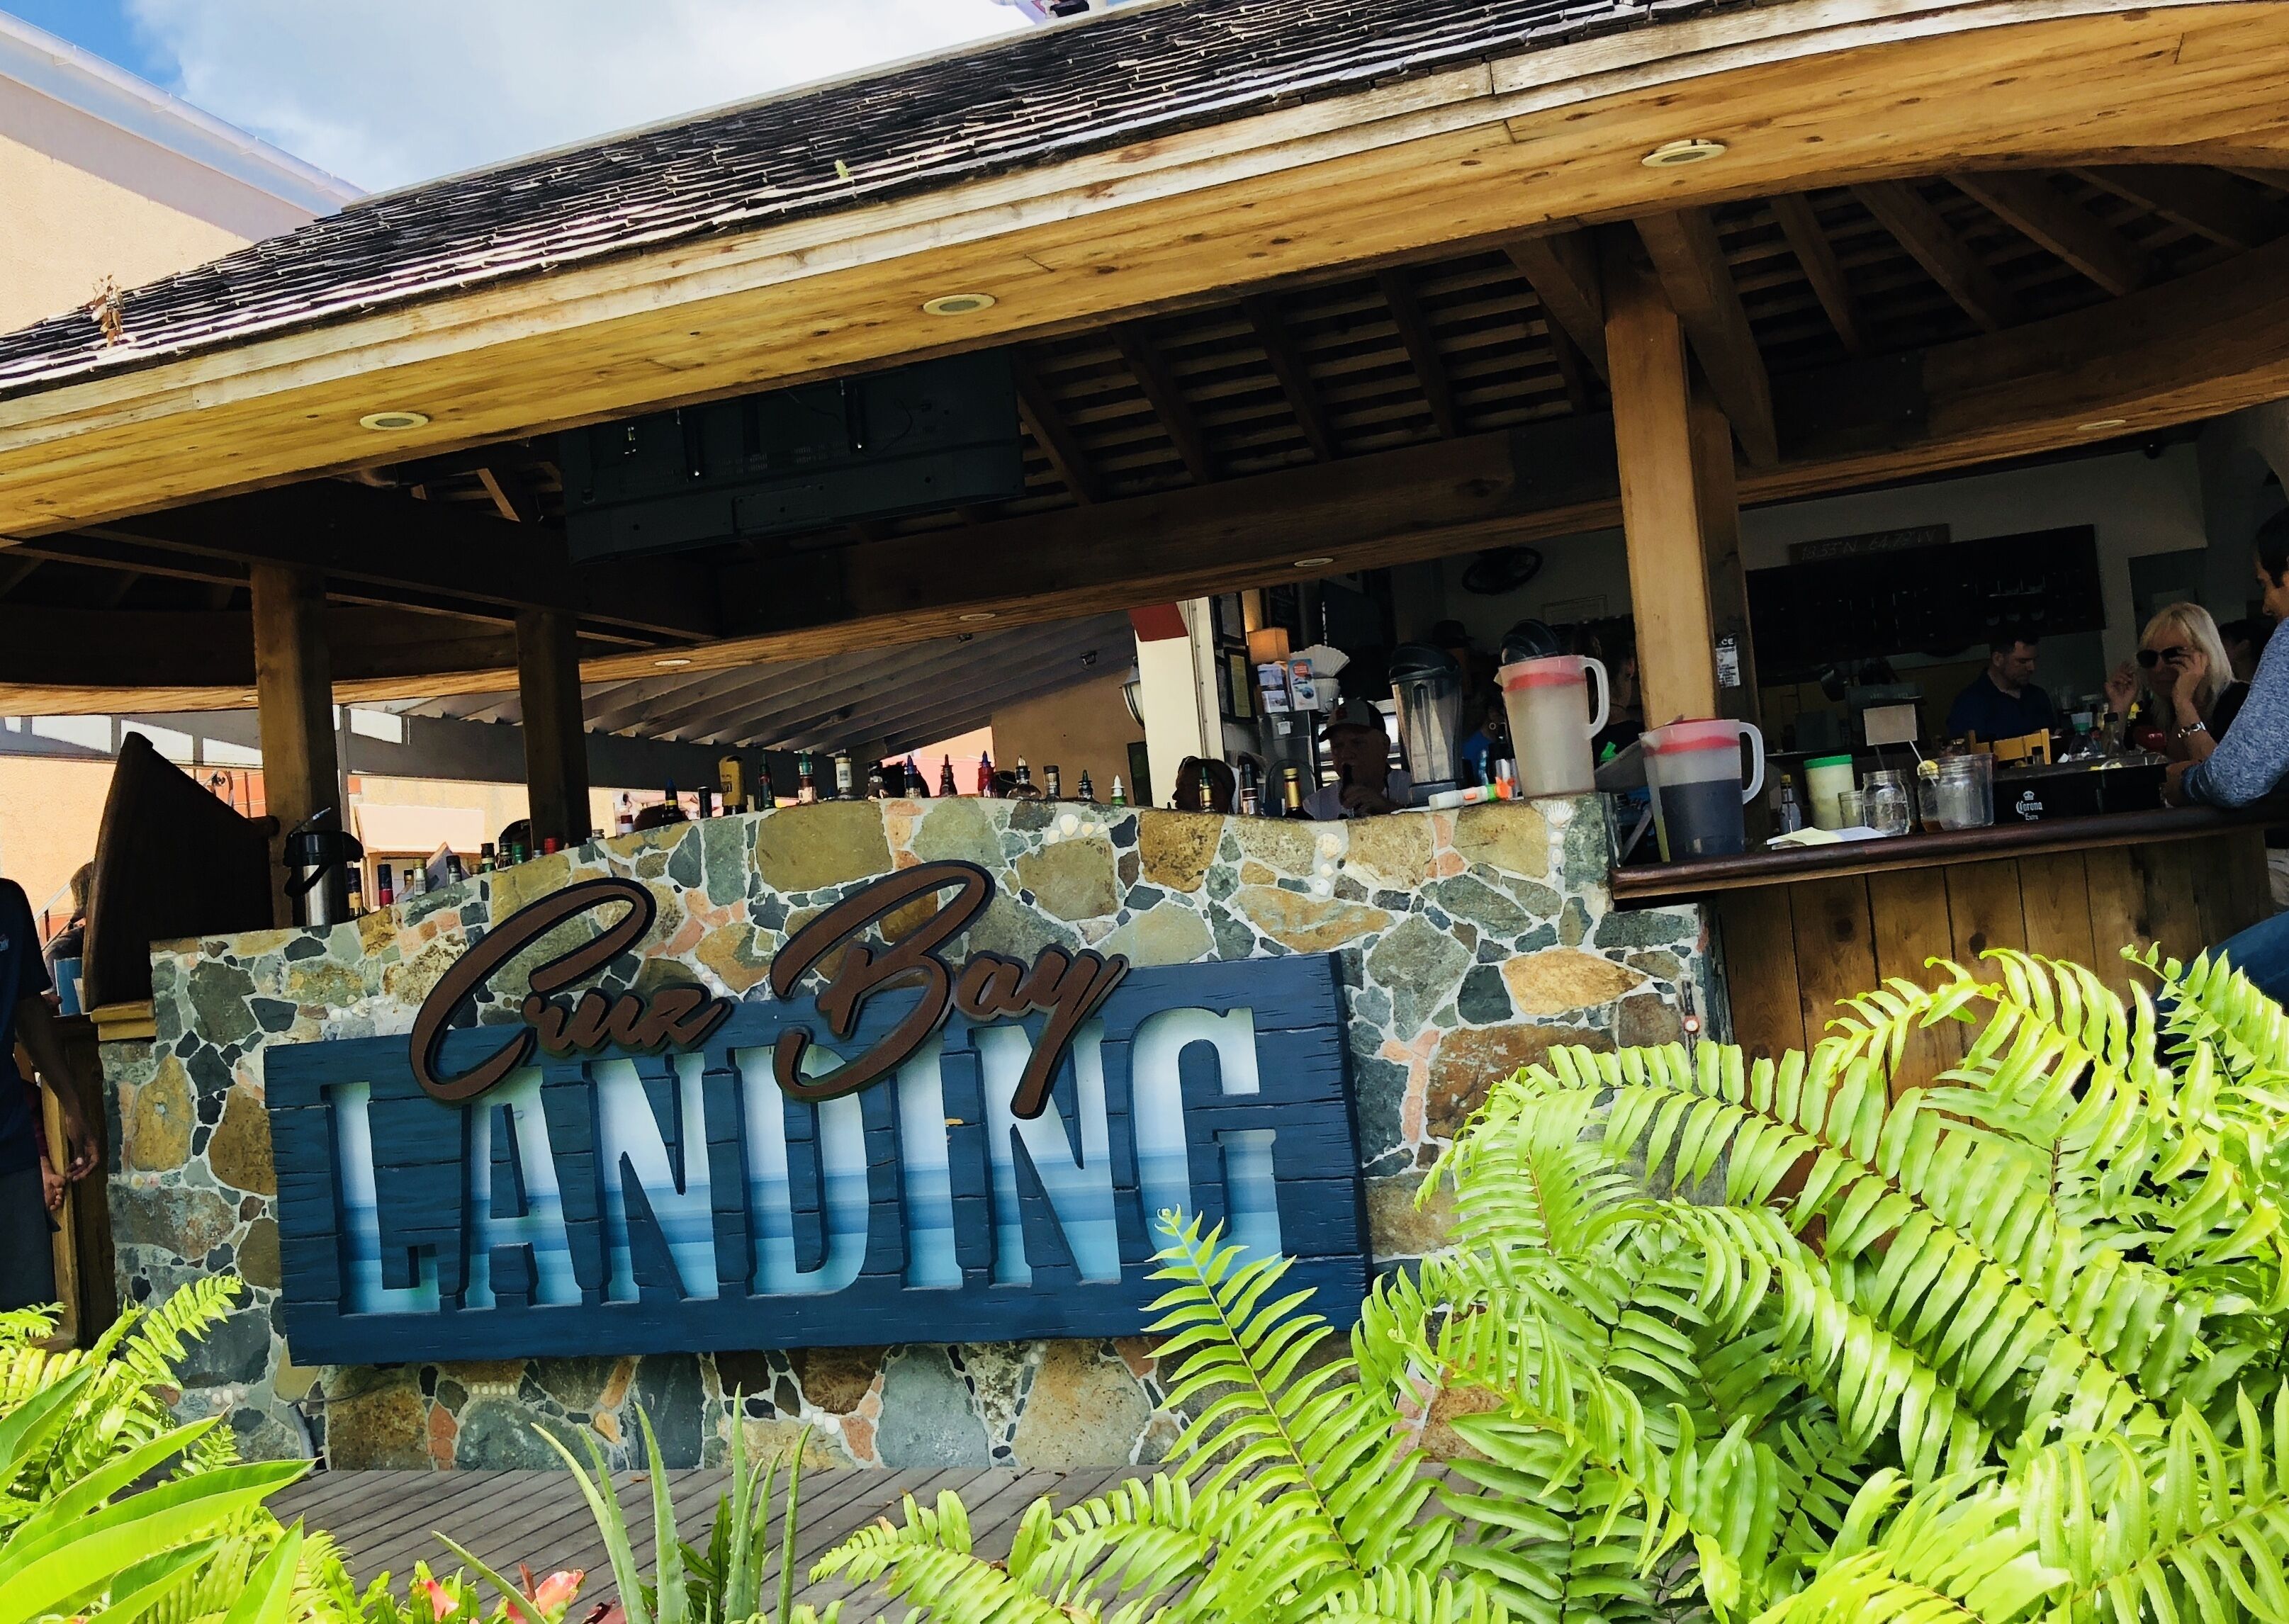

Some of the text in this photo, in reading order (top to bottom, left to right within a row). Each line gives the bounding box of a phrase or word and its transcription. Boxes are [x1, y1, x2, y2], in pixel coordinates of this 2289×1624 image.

[2016, 800, 2043, 815] Corona
[410, 859, 1131, 1120] Cruz Bay
[321, 1005, 1283, 1315] LANDING
